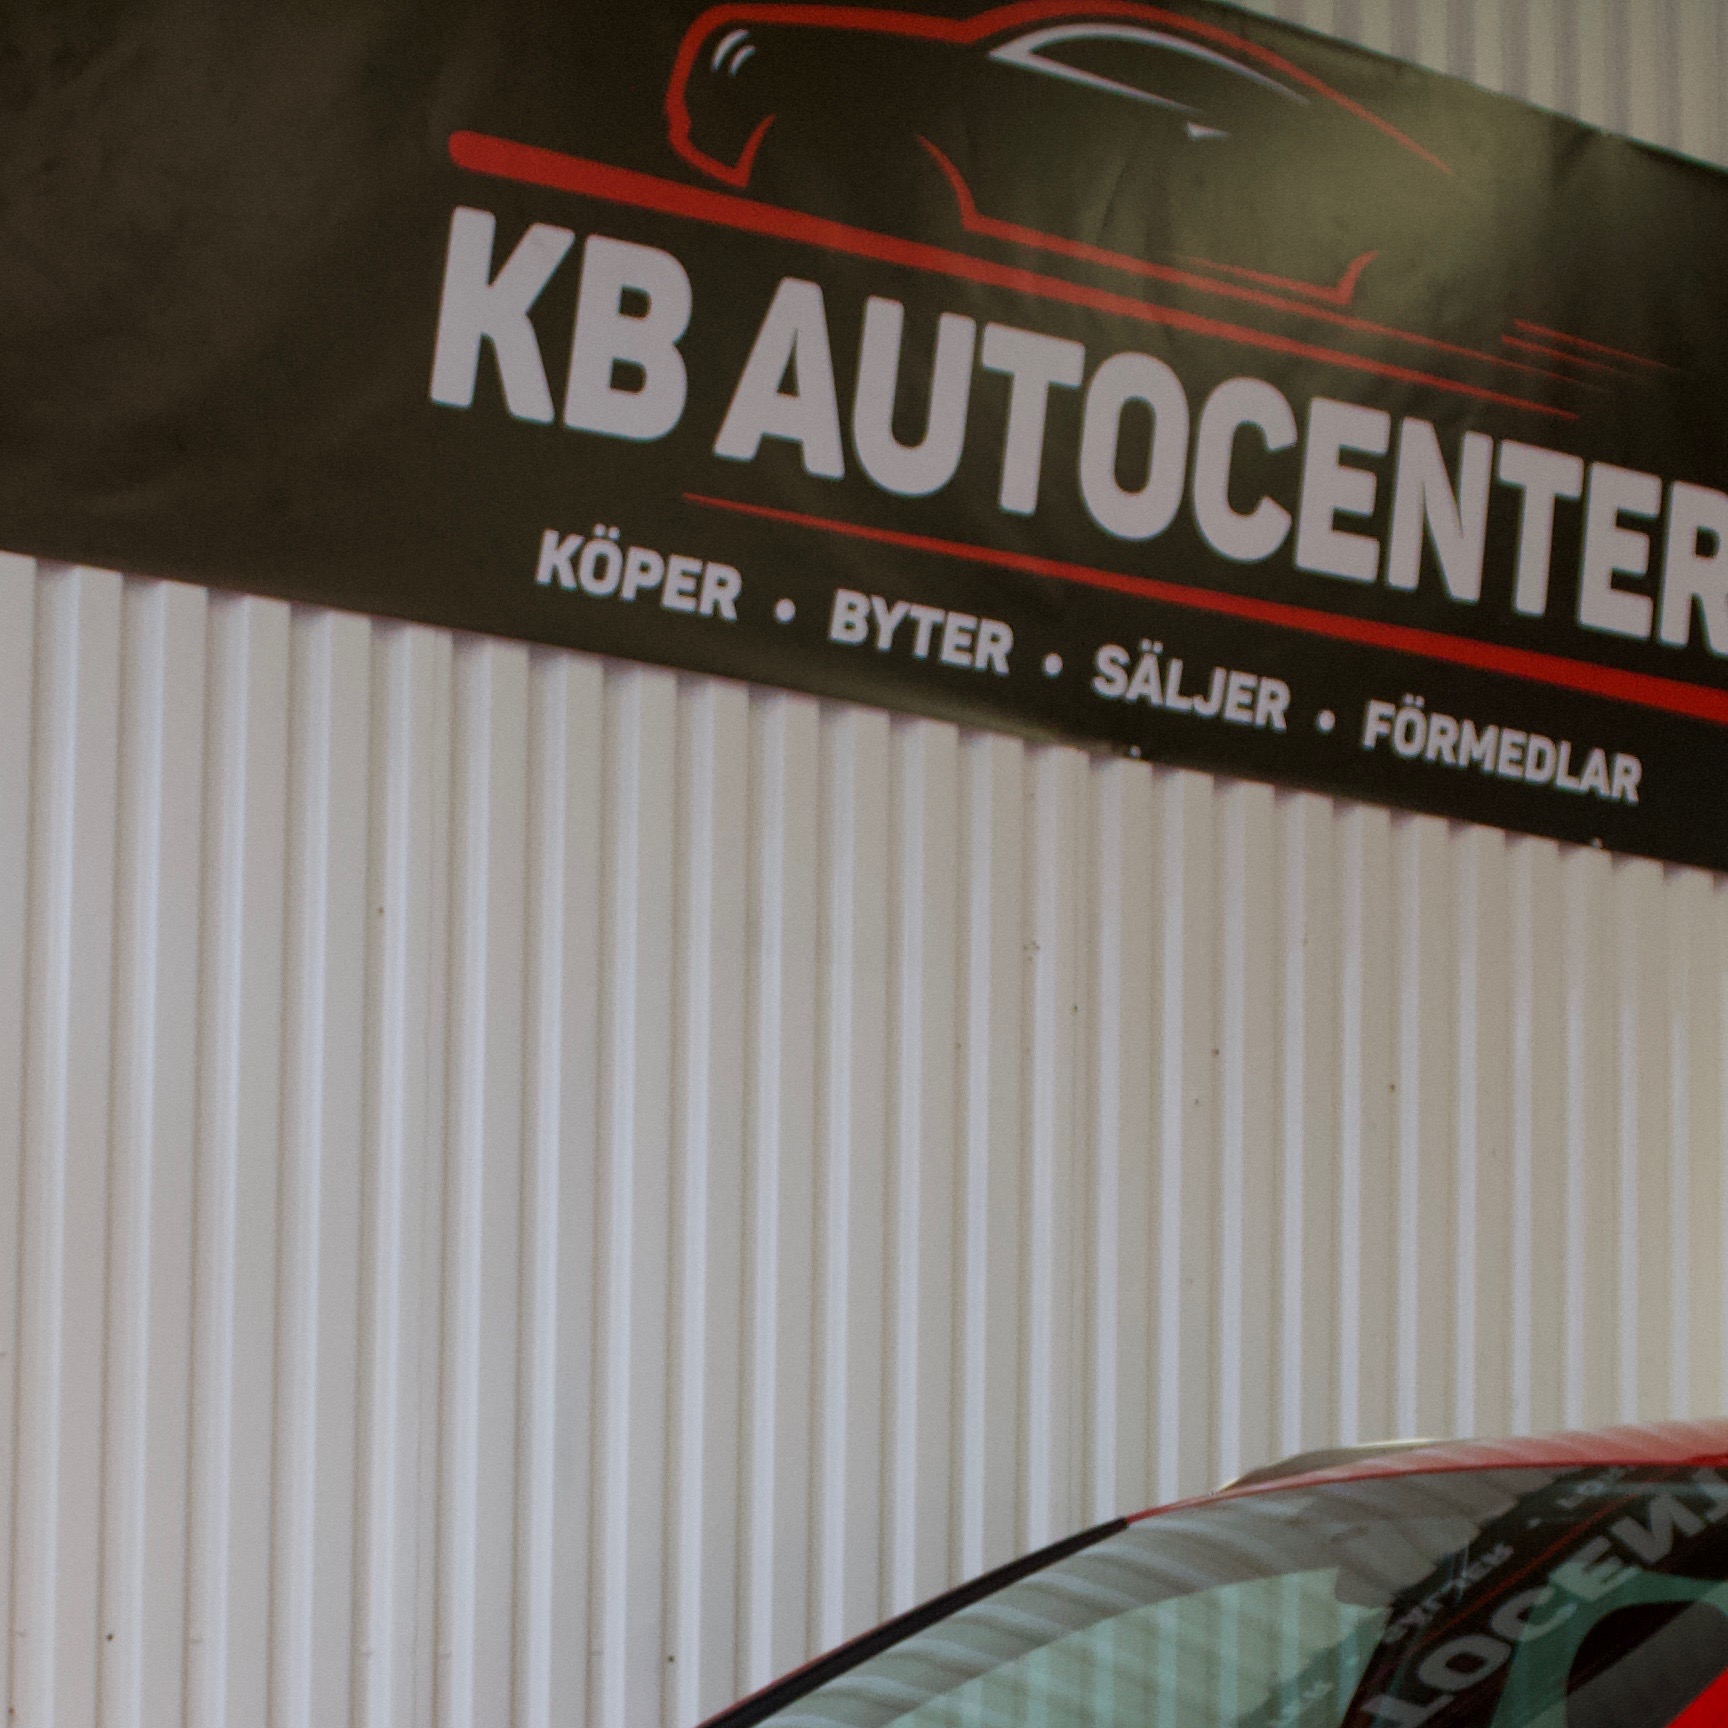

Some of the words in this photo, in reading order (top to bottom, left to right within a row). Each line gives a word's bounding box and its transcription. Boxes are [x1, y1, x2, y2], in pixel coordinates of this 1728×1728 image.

[431, 208, 691, 440] KB
[537, 525, 741, 620] KÖPER
[830, 589, 1013, 674] BYTER
[1093, 640, 1289, 730] SÄLJER
[1363, 694, 1641, 806] FÖRMEDLAR
